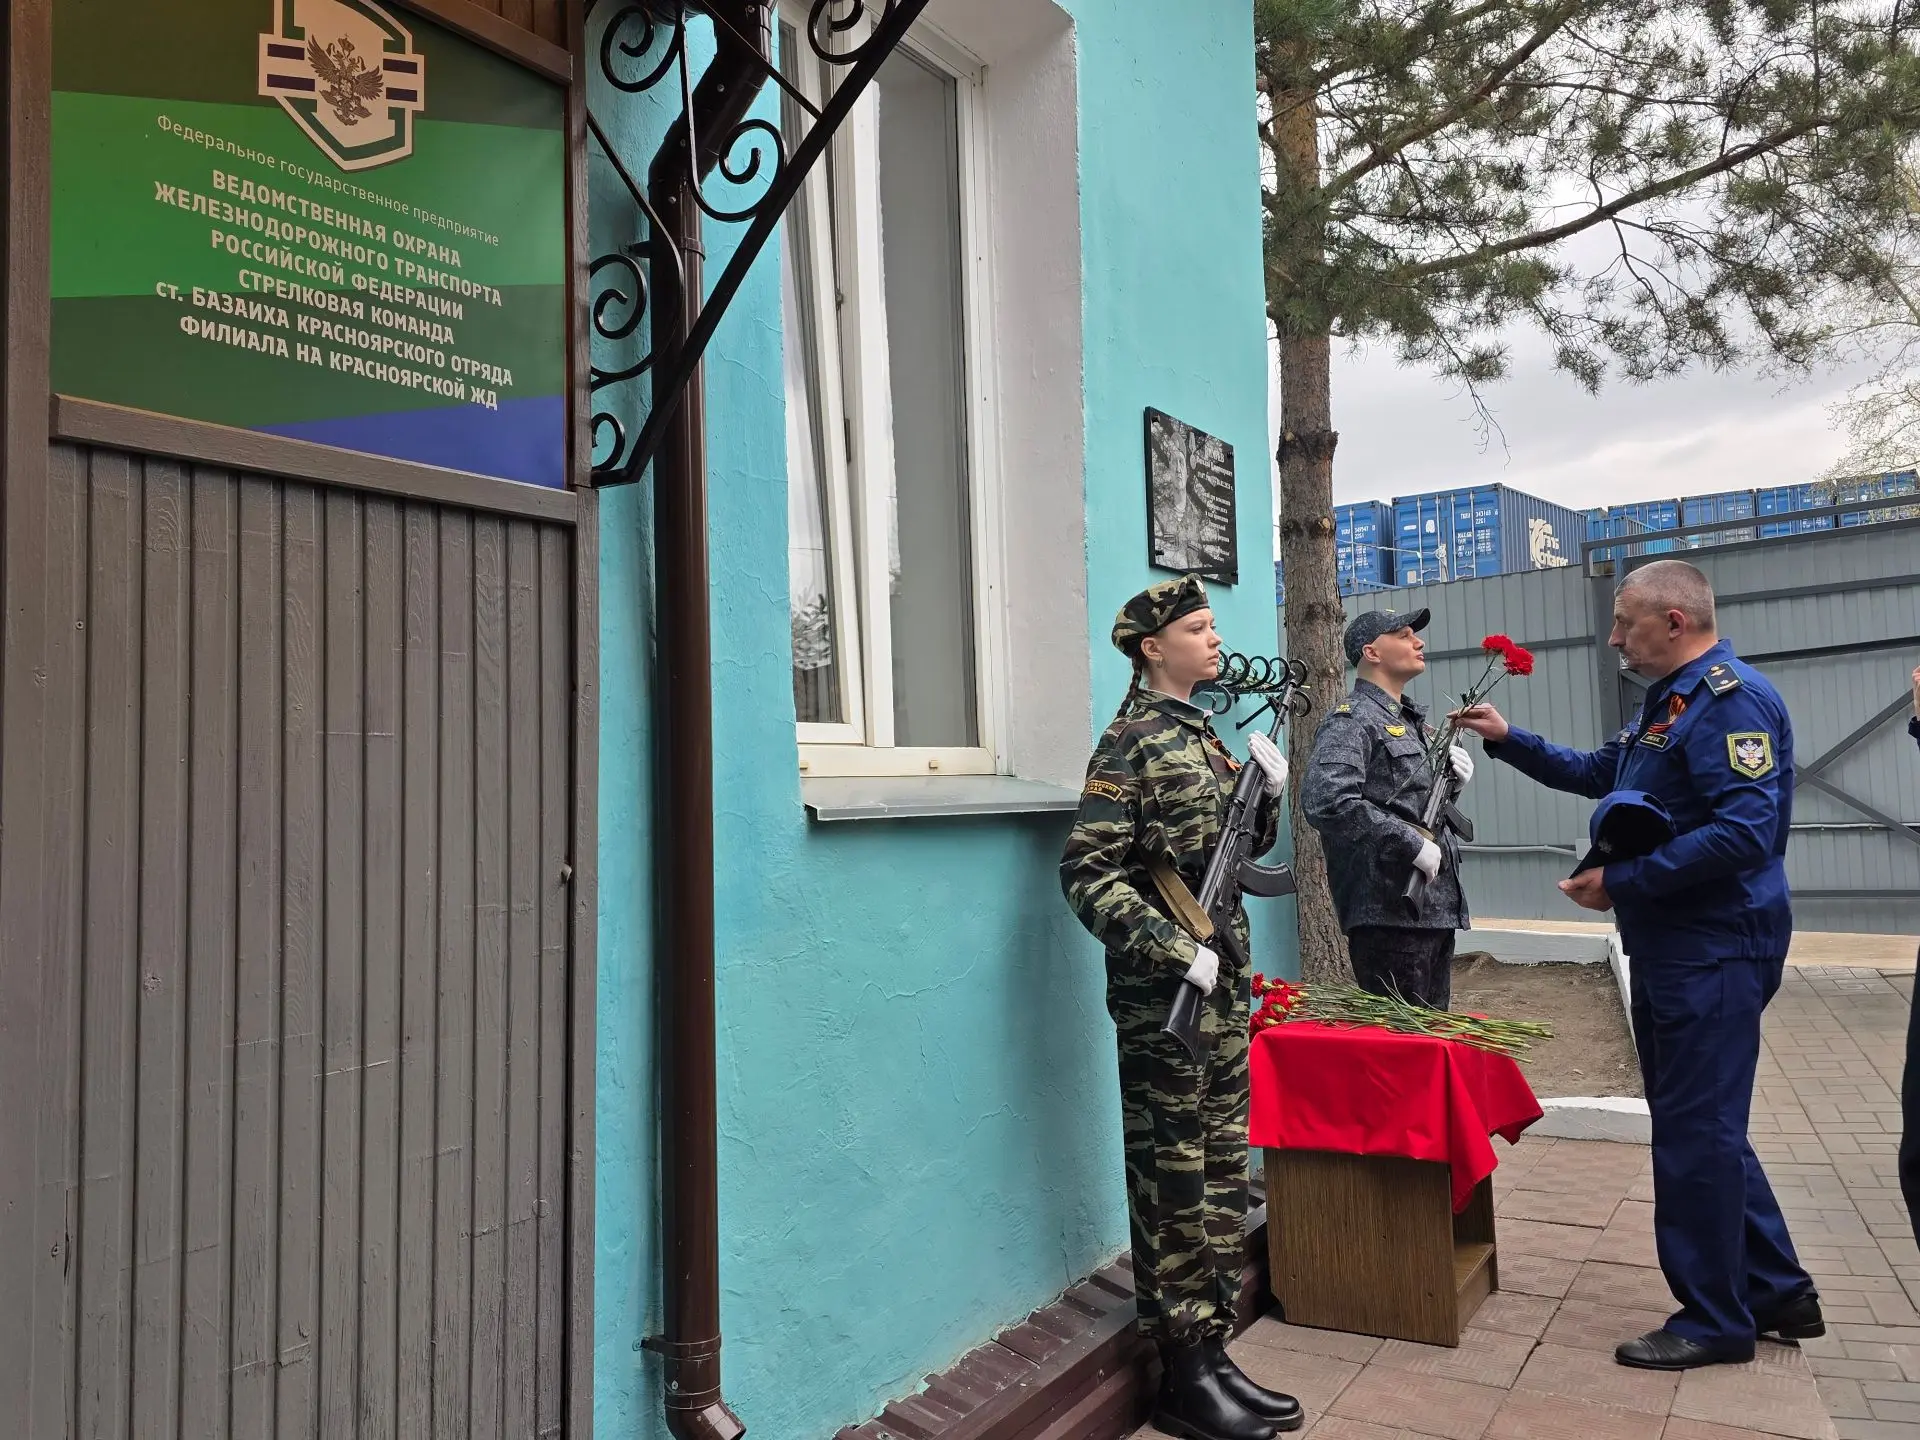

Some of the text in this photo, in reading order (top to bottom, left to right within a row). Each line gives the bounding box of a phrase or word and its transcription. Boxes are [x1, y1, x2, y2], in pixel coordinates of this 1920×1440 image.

[157, 115, 500, 247] Федеральное государственное предприятие
[212, 170, 461, 268] ВЕДОМСТВЕННАЯ ОХРАНА
[155, 181, 502, 306] ЖЕЛЕЗНОДОРОЖНОГО ТРАНСПОРТА
[211, 229, 464, 320] РОССИЙСКОЙ ФЕДЕРАЦИИ
[192, 287, 289, 329] БАЗАИХА
[297, 314, 445, 368] КРАСНОЯРСКОГО
[451, 355, 513, 386] ОТРЯДА
[239, 269, 454, 345] СТРЕЛКОВАЯ КОМАНДА
[180, 314, 498, 411] ФИЛИАЛА НА КРАСНОЯРСКОЙ ЖД
